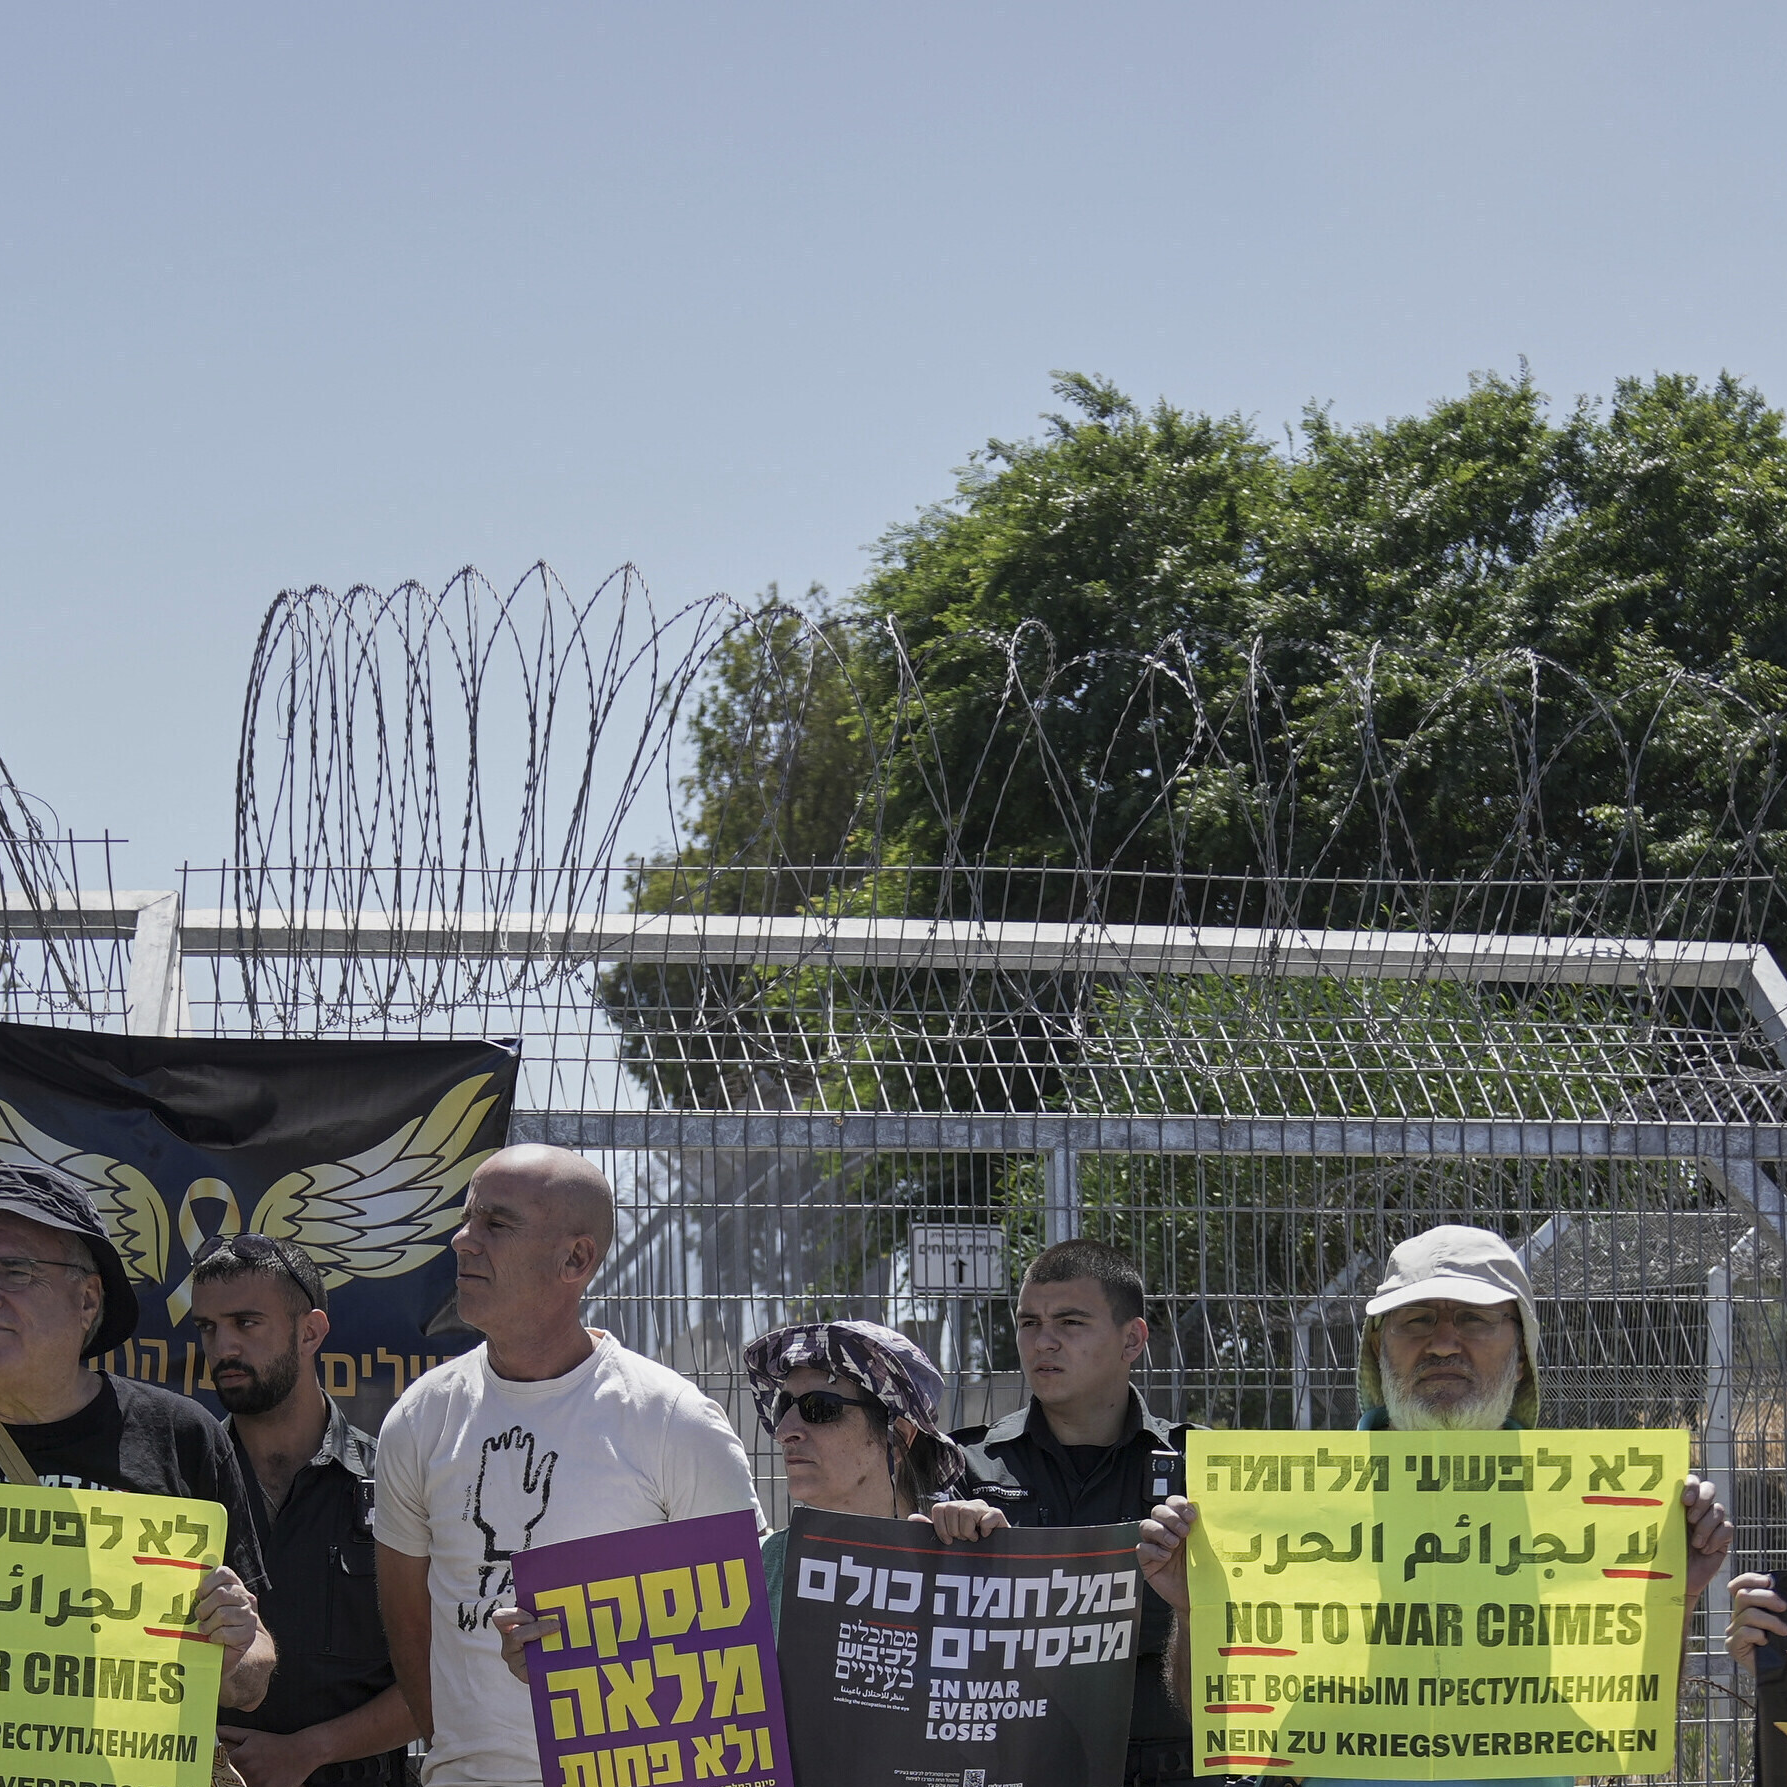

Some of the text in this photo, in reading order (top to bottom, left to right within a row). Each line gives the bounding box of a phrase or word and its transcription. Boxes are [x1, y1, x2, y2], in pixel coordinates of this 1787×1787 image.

[321, 1347, 455, 1397] יילים
[1207, 1447, 1664, 1492] לא לפשעי מלחמה
[137, 1515, 209, 1558] לא
[1220, 1514, 1658, 1583] لا لجرائم الحرب
[158, 1576, 199, 1626] لا
[533, 1558, 752, 1659] עסקה
[797, 1554, 1137, 1619] במלחמה כולם
[839, 1619, 918, 1647] מסתכלים
[930, 1619, 1132, 1671] מפסידים
[1225, 1602, 1643, 1647] NO TO WAR CRIMES
[835, 1659, 914, 1691] בעיניים
[837, 1641, 917, 1666] לכיבוש
[24, 1652, 186, 1705] CRIMES
[546, 1643, 767, 1740] מלאה
[929, 1678, 1020, 1699] IN WAR
[1205, 1674, 1659, 1707] НЕТ ВОЕННЫМ ПРЕСТУПЛЕНИЯМ
[926, 1720, 997, 1741] LOSES
[927, 1699, 1046, 1720] EVERYONE
[692, 1724, 775, 1780] ולא
[1207, 1730, 1657, 1758] NEIN ZU KRIEGSVERBRECHEN
[755, 1779, 776, 1787] סיום
